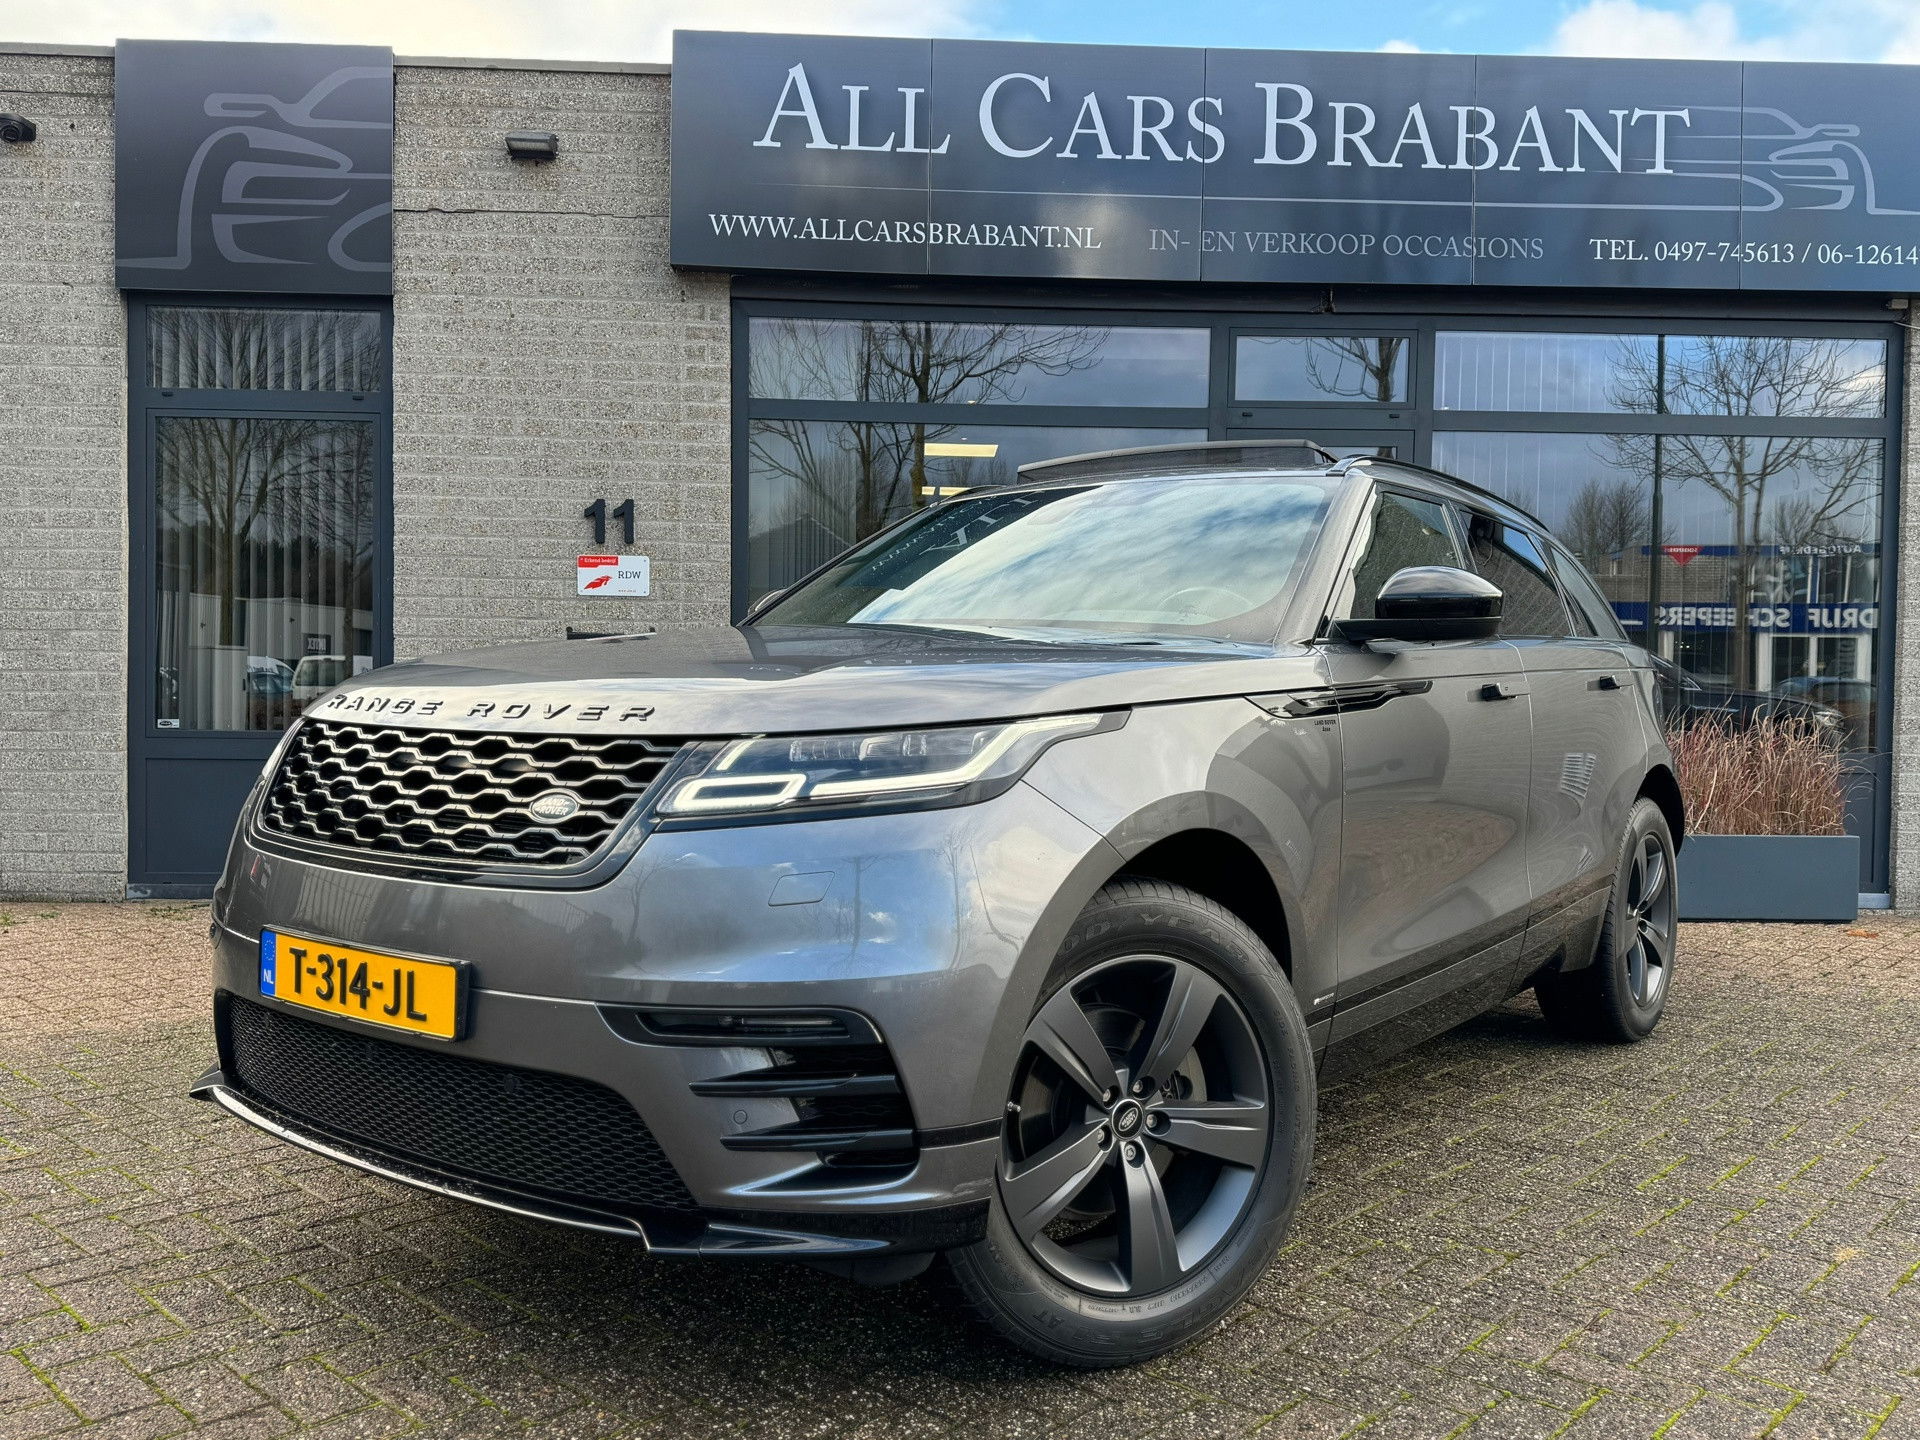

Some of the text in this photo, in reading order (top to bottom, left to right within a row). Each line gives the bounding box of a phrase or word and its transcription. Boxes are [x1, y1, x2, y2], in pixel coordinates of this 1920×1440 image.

[753, 62, 1692, 174] ALL CARS BRABANT
[708, 213, 1102, 249] WWW.ALLCARSBRABANT.NL
[1148, 228, 1544, 259] IN- EN VERKOOP OCCASIONS
[1589, 238, 1649, 261] TEL.
[1654, 241, 1795, 263] 0497-745613
[1817, 243, 1920, 265] 06-12614
[584, 498, 634, 545] 11
[618, 570, 641, 579] RDW
[327, 693, 655, 722] RANGE ROVER
[263, 968, 275, 985] NL
[289, 947, 428, 1022] T-314-JL
